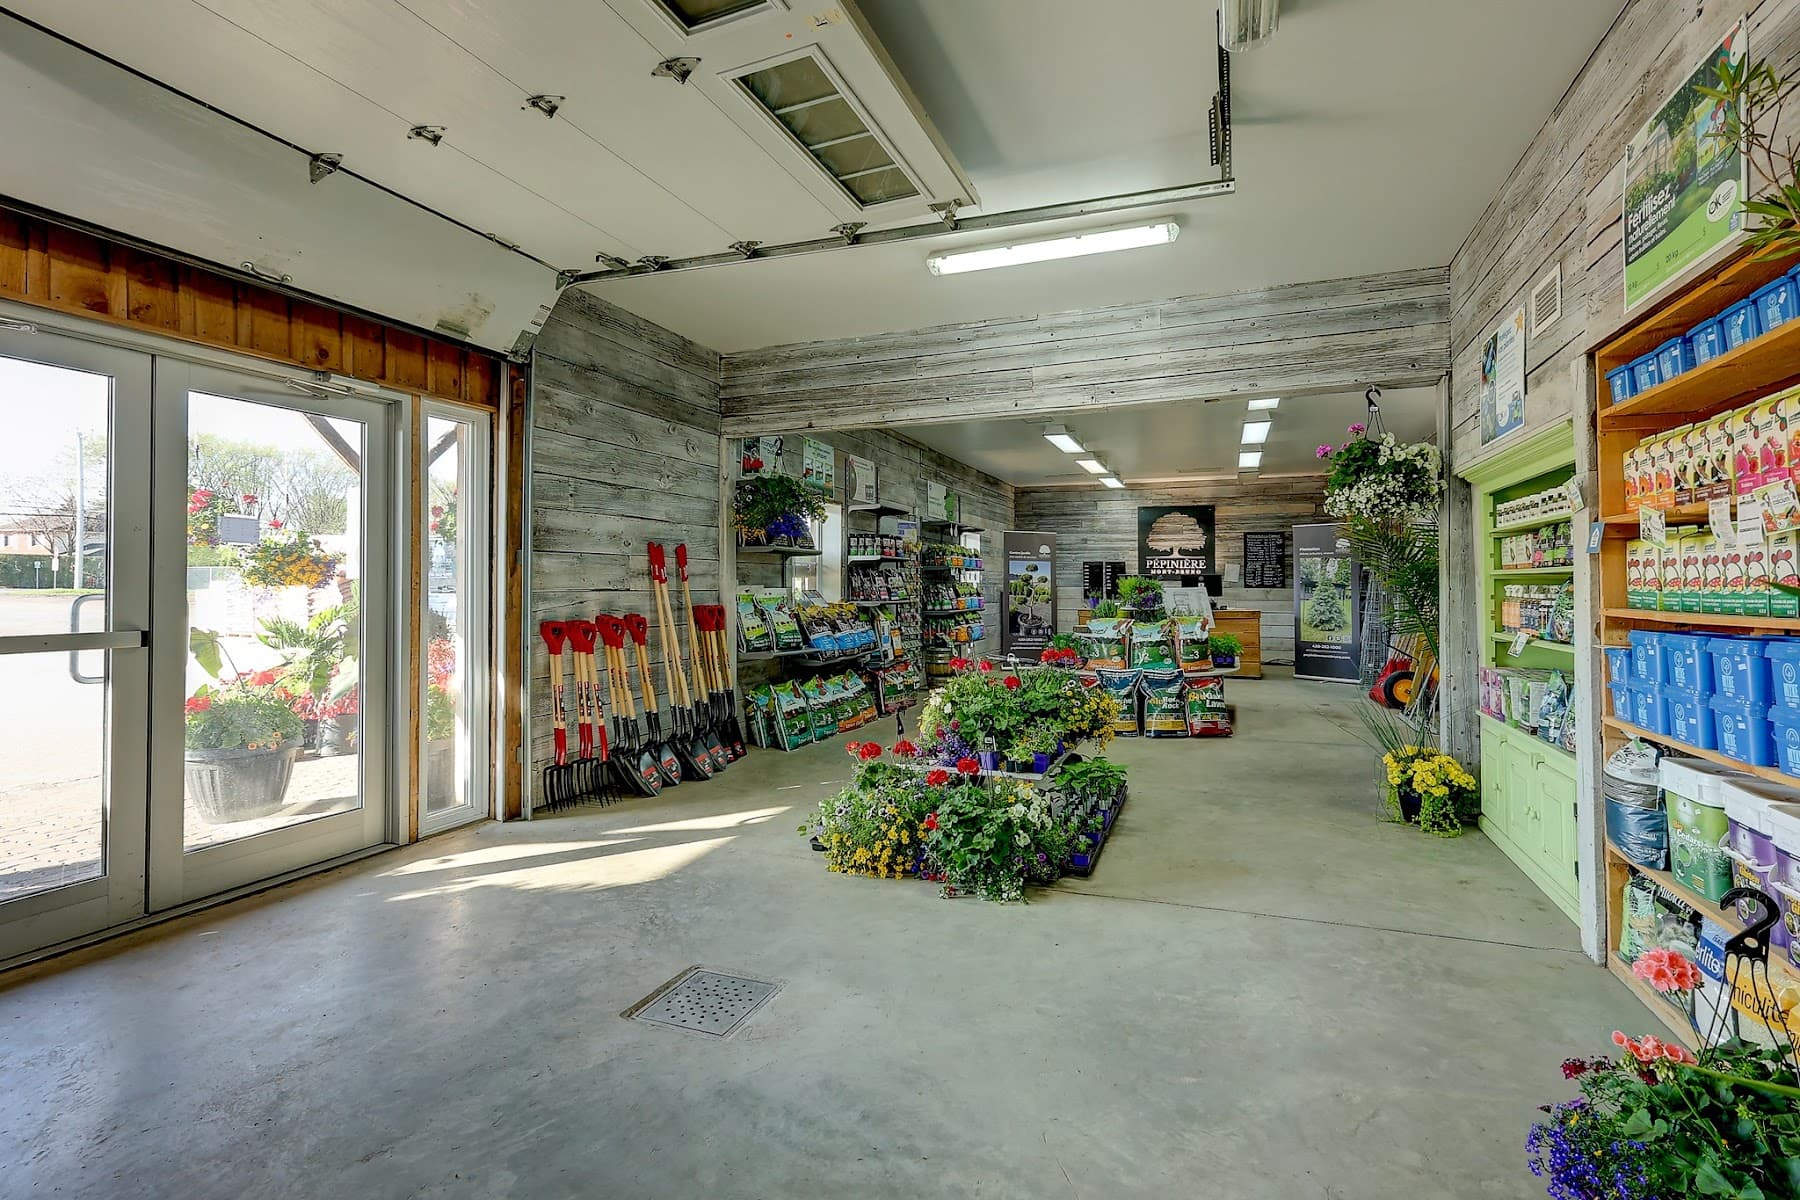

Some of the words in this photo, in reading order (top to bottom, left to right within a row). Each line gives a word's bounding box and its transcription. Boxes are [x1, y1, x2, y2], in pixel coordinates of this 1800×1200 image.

[1627, 183, 1671, 233] Fertilisez
[1628, 194, 1676, 245] naturellement
[1146, 558, 1207, 569] PÉPINIÈRE
